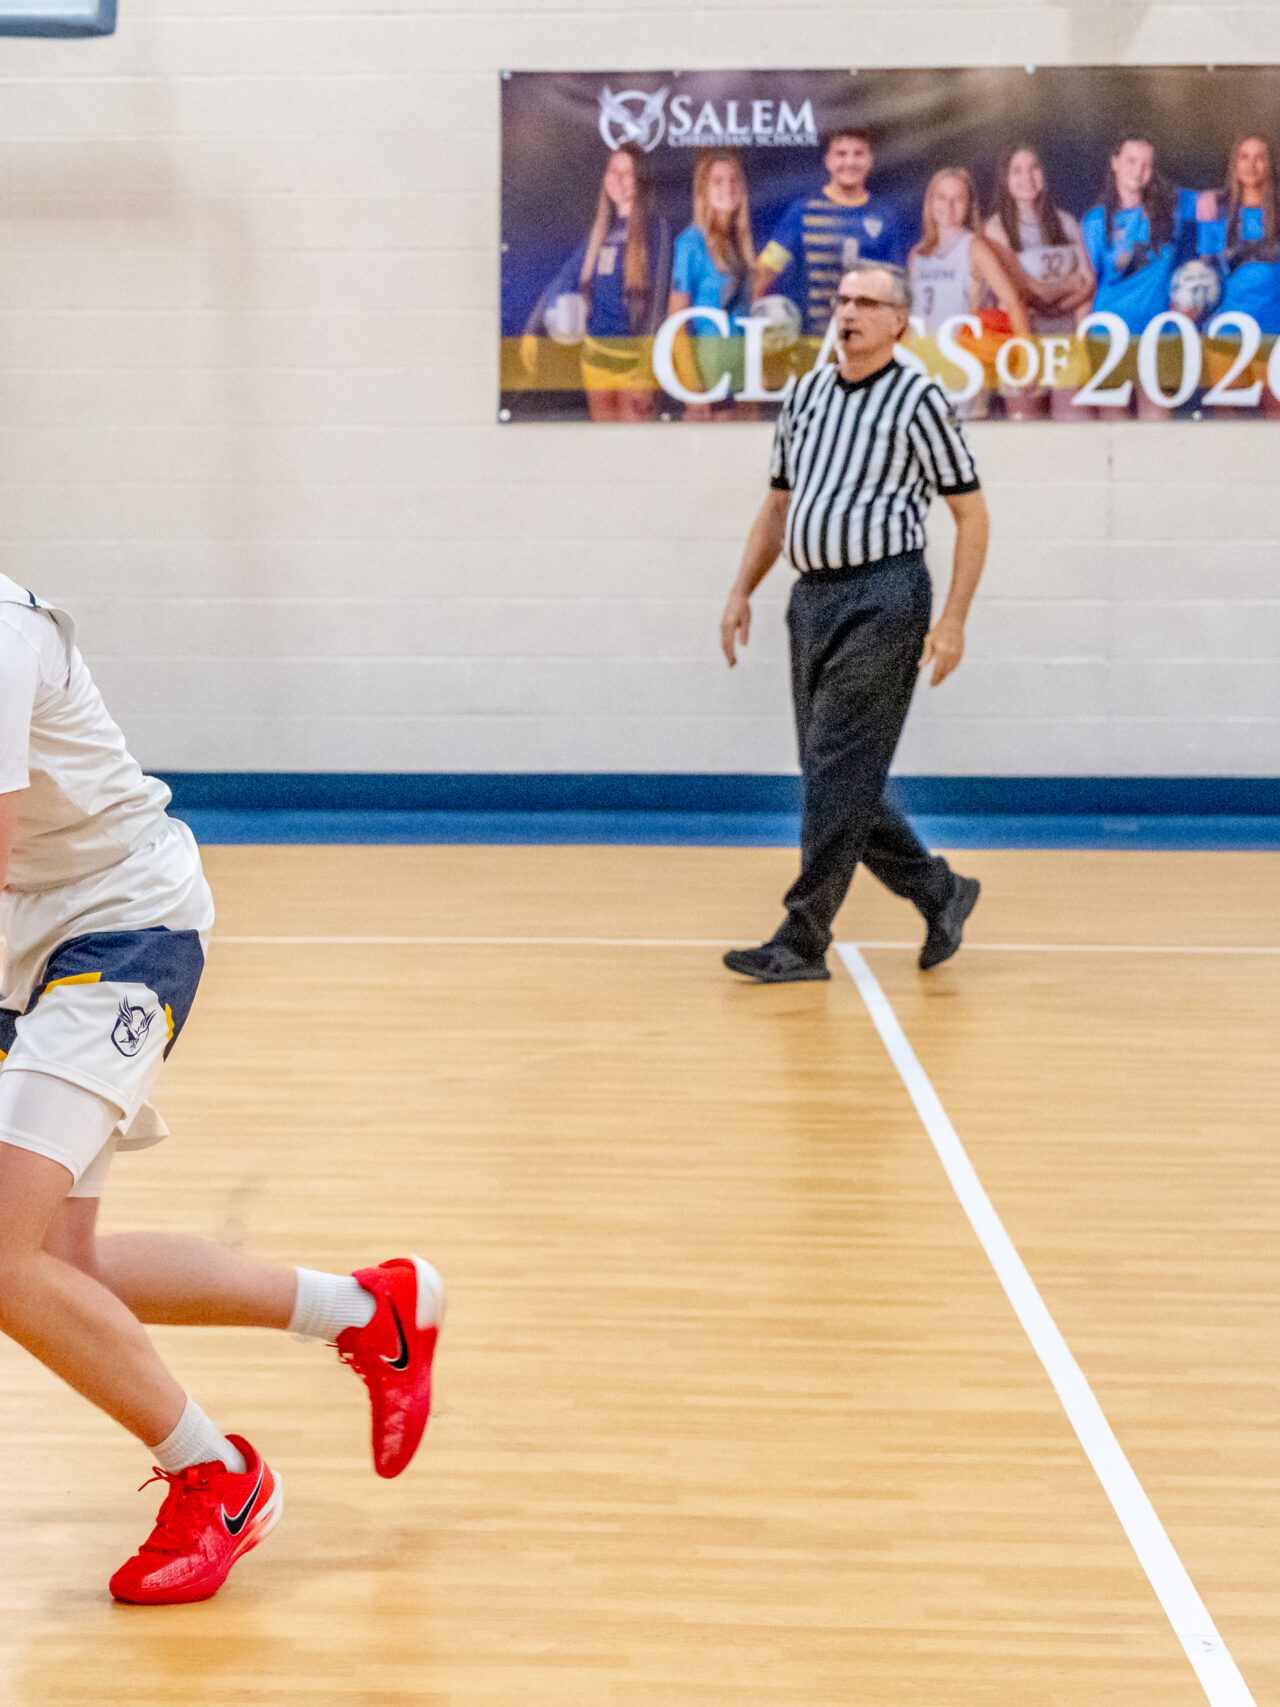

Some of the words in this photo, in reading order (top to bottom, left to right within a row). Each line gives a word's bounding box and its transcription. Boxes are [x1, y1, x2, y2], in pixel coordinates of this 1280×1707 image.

[669, 94, 818, 135] SALEM
[995, 338, 1071, 387] OF
[1071, 311, 1280, 408] 202
